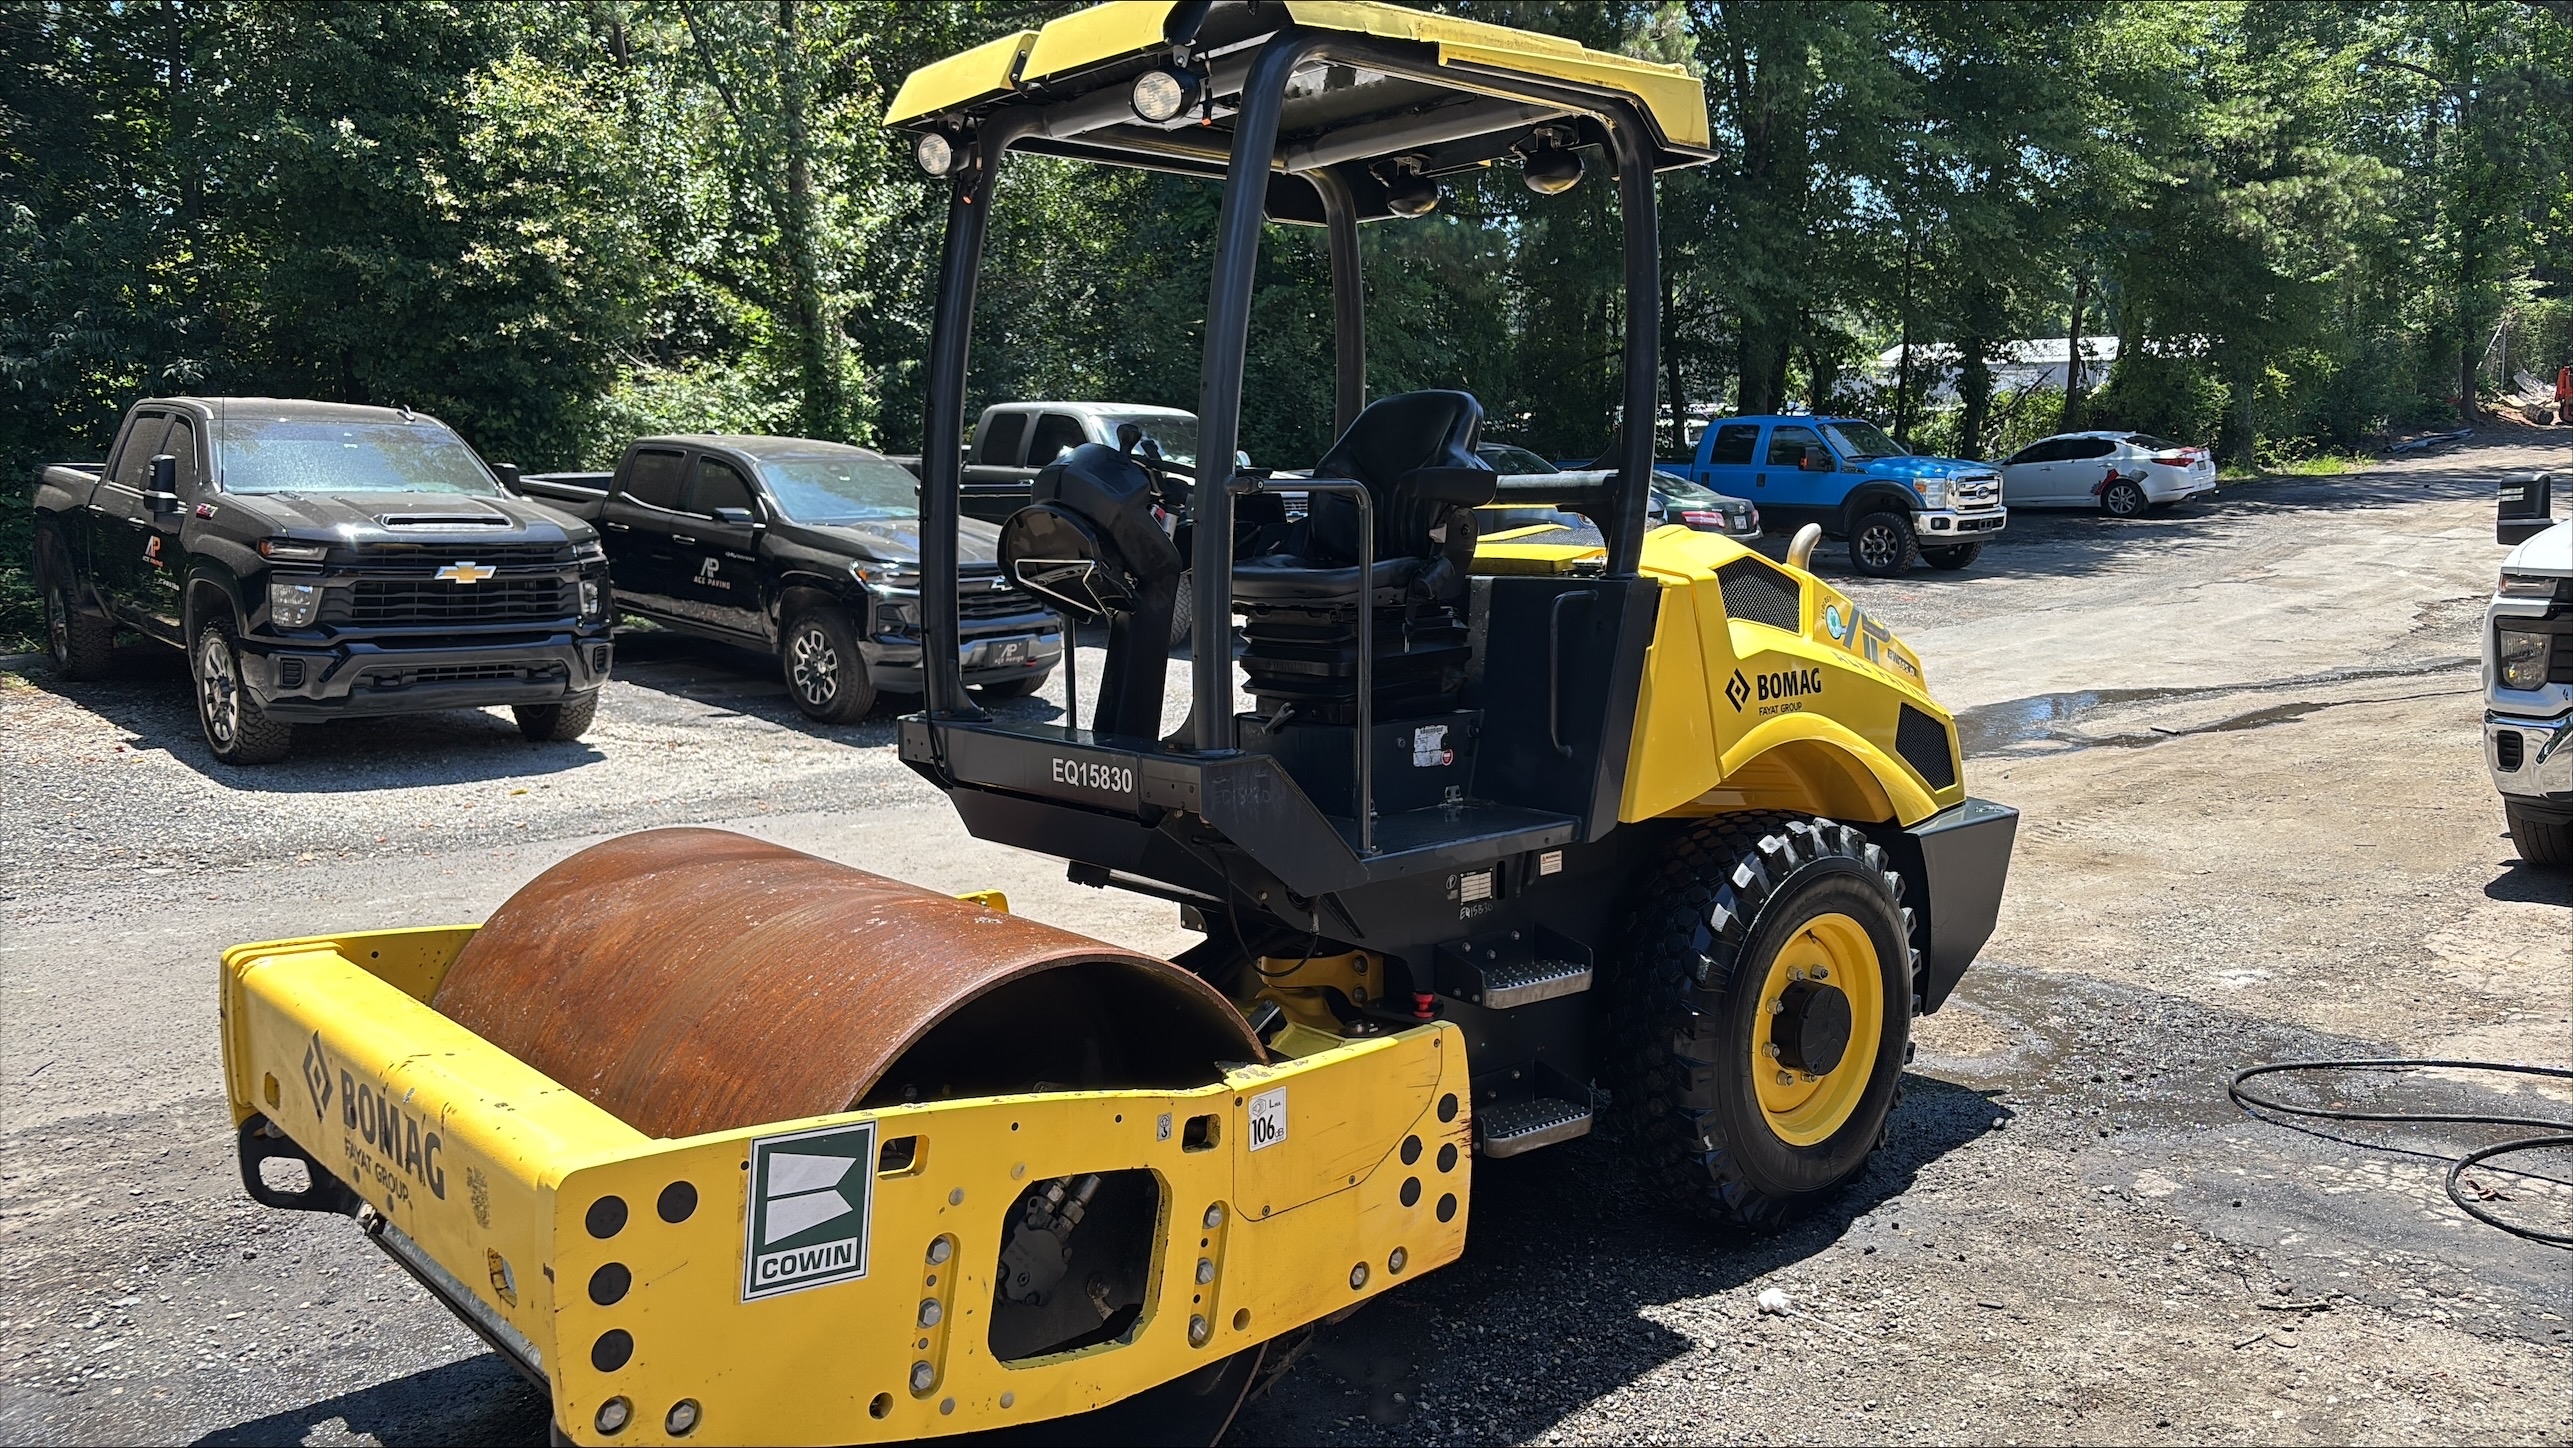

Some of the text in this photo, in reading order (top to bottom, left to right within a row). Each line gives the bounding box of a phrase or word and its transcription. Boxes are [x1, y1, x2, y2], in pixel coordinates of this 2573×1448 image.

[694, 576, 730, 589] ACE PAVING
[700, 557, 719, 578] AP
[1757, 667, 1822, 701] BOMAG
[1759, 702, 1802, 716] FAYAT GROUP
[1052, 757, 1133, 793] EQ15830
[341, 1067, 445, 1201] BOMAG
[1252, 1114, 1275, 1145] 106
[344, 1135, 410, 1203] FAYAT GROUP
[762, 1243, 852, 1279] COWIN
